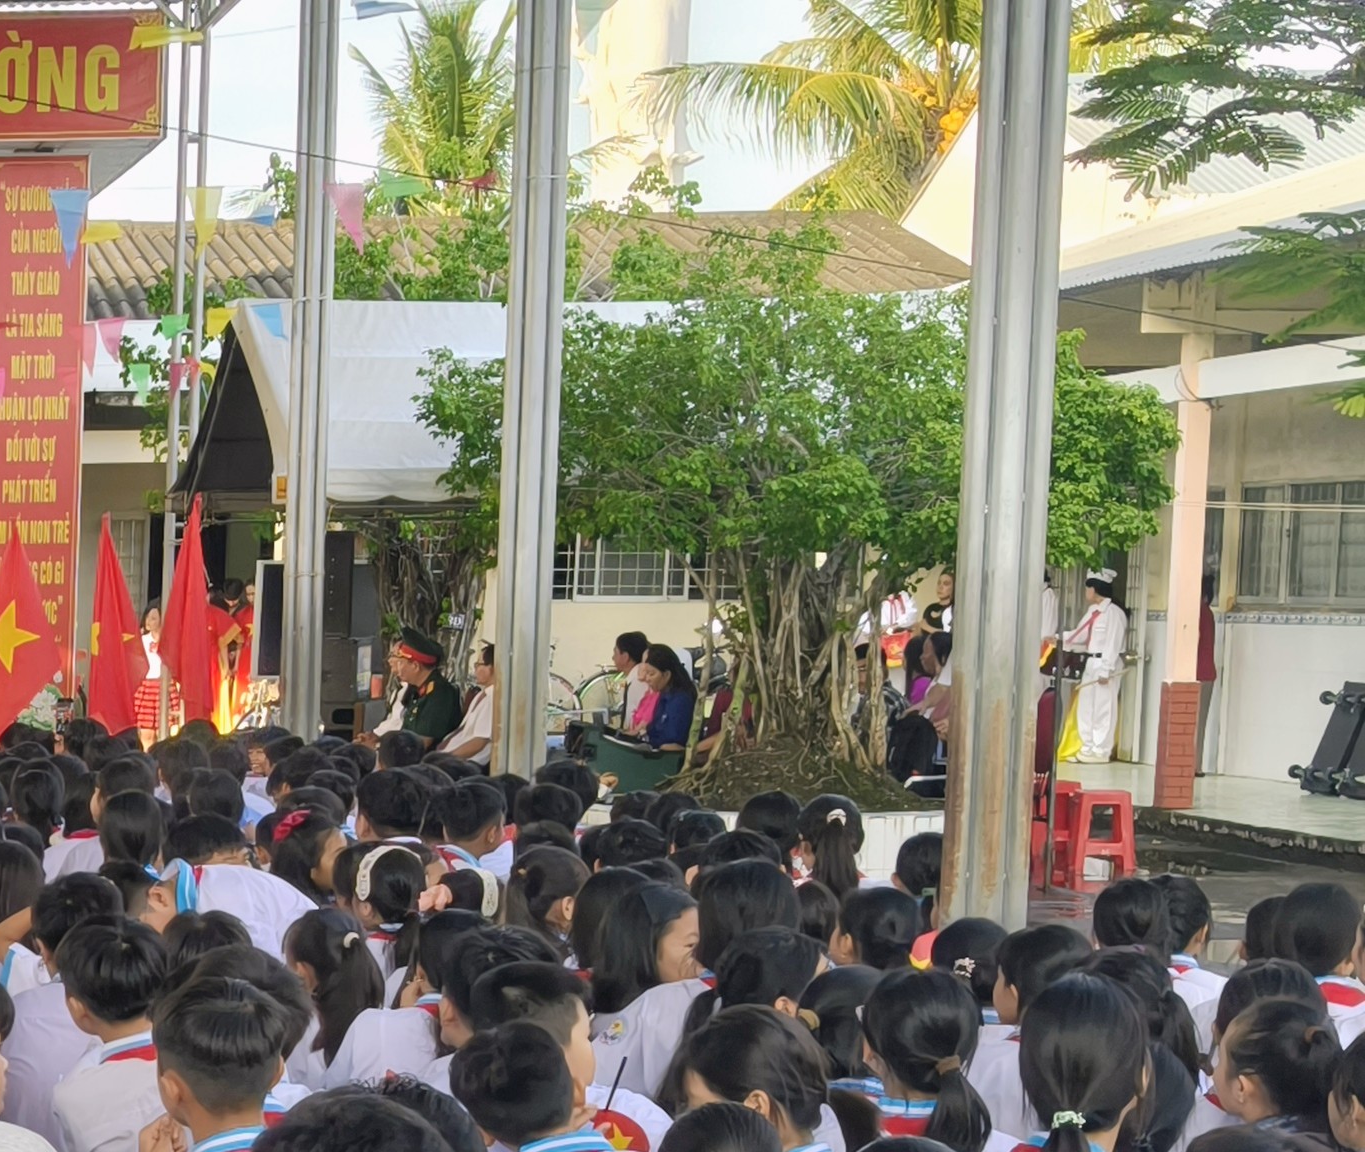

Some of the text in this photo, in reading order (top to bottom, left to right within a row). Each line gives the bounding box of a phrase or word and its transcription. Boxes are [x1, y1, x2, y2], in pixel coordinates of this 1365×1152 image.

[11, 221, 62, 253] CỦA NGƯỜI
[37, 265, 60, 296] GIÁO
[19, 313, 35, 337] TIA
[36, 308, 63, 337] SÁNG
[33, 349, 55, 379] TRỜI
[27, 394, 43, 426] LỢI
[44, 388, 70, 420] NHẤT
[41, 435, 57, 467] SỰ
[1, 469, 57, 504] PHÁT TRIỂN
[30, 519, 51, 545] NON
[52, 511, 70, 545] TRẺ
[40, 555, 53, 585] CÓ
[54, 555, 64, 585] GÌ
